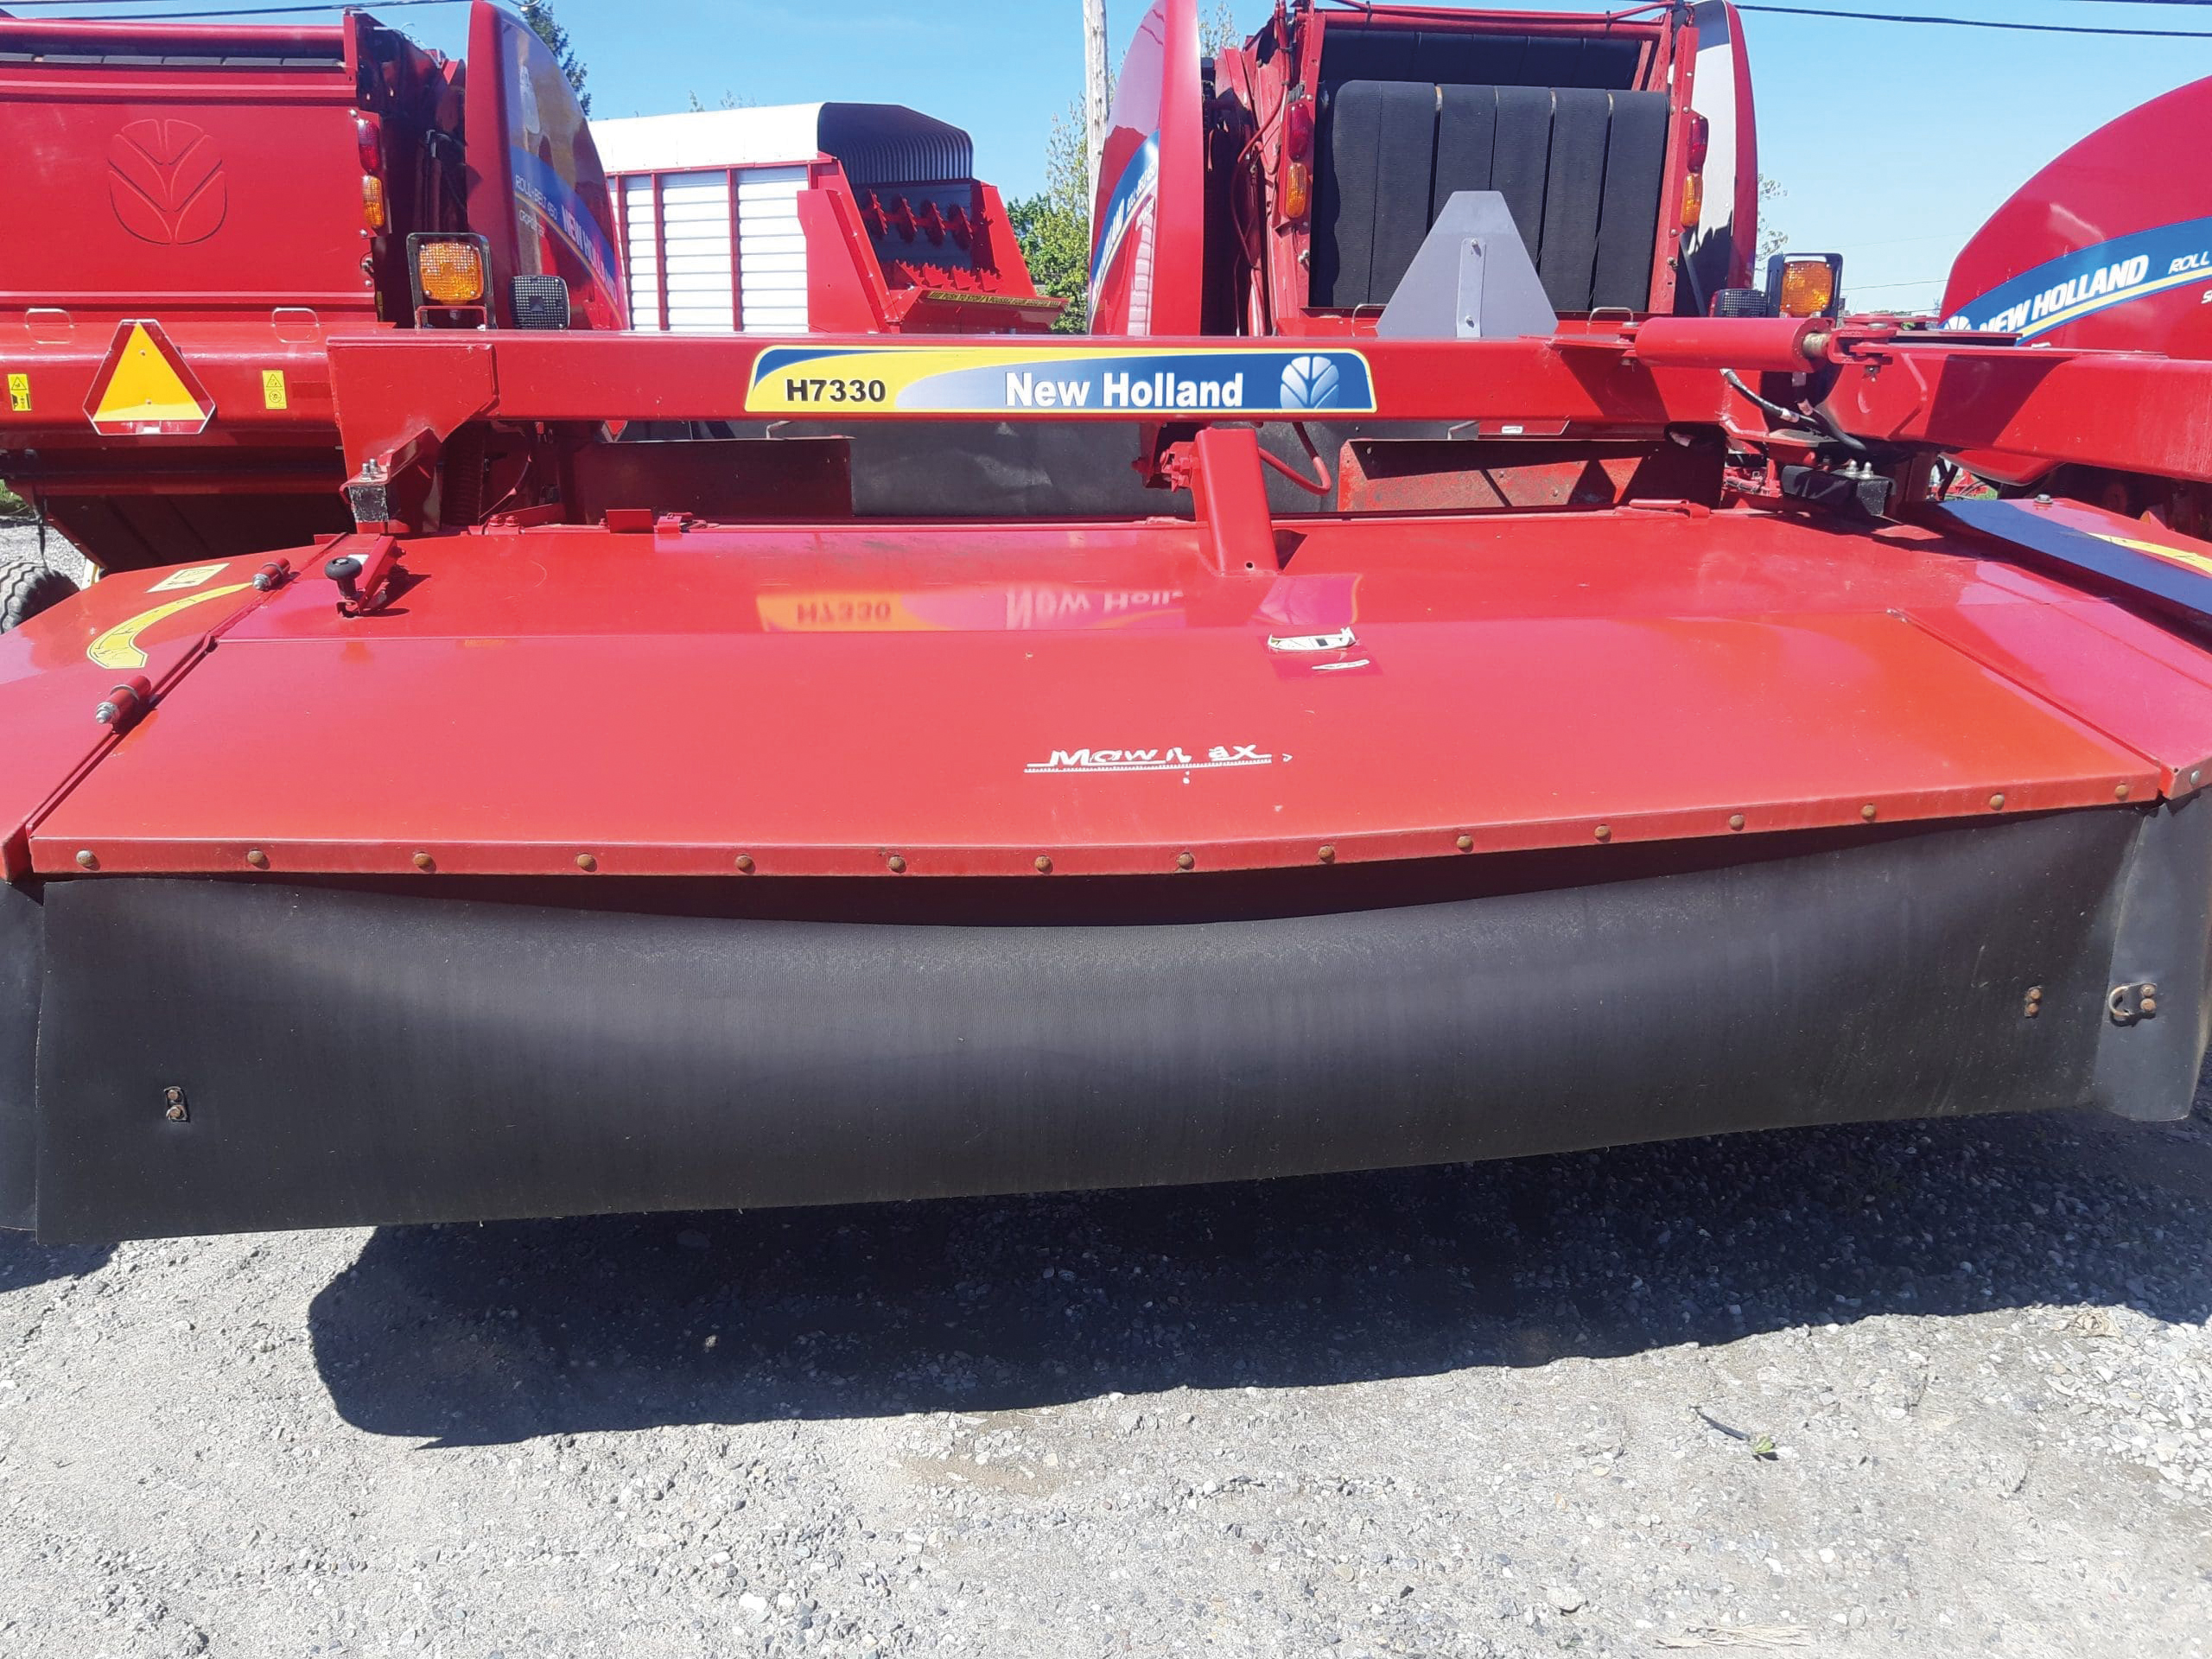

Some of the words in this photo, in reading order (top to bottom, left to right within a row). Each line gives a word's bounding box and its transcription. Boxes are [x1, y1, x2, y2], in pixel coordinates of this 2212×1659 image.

[2168, 251, 2209, 274] ROLL
[2031, 255, 2149, 321] HOLLAND
[786, 379, 887, 402] H7330
[1006, 372, 1090, 407] New
[1103, 372, 1243, 407] Holland
